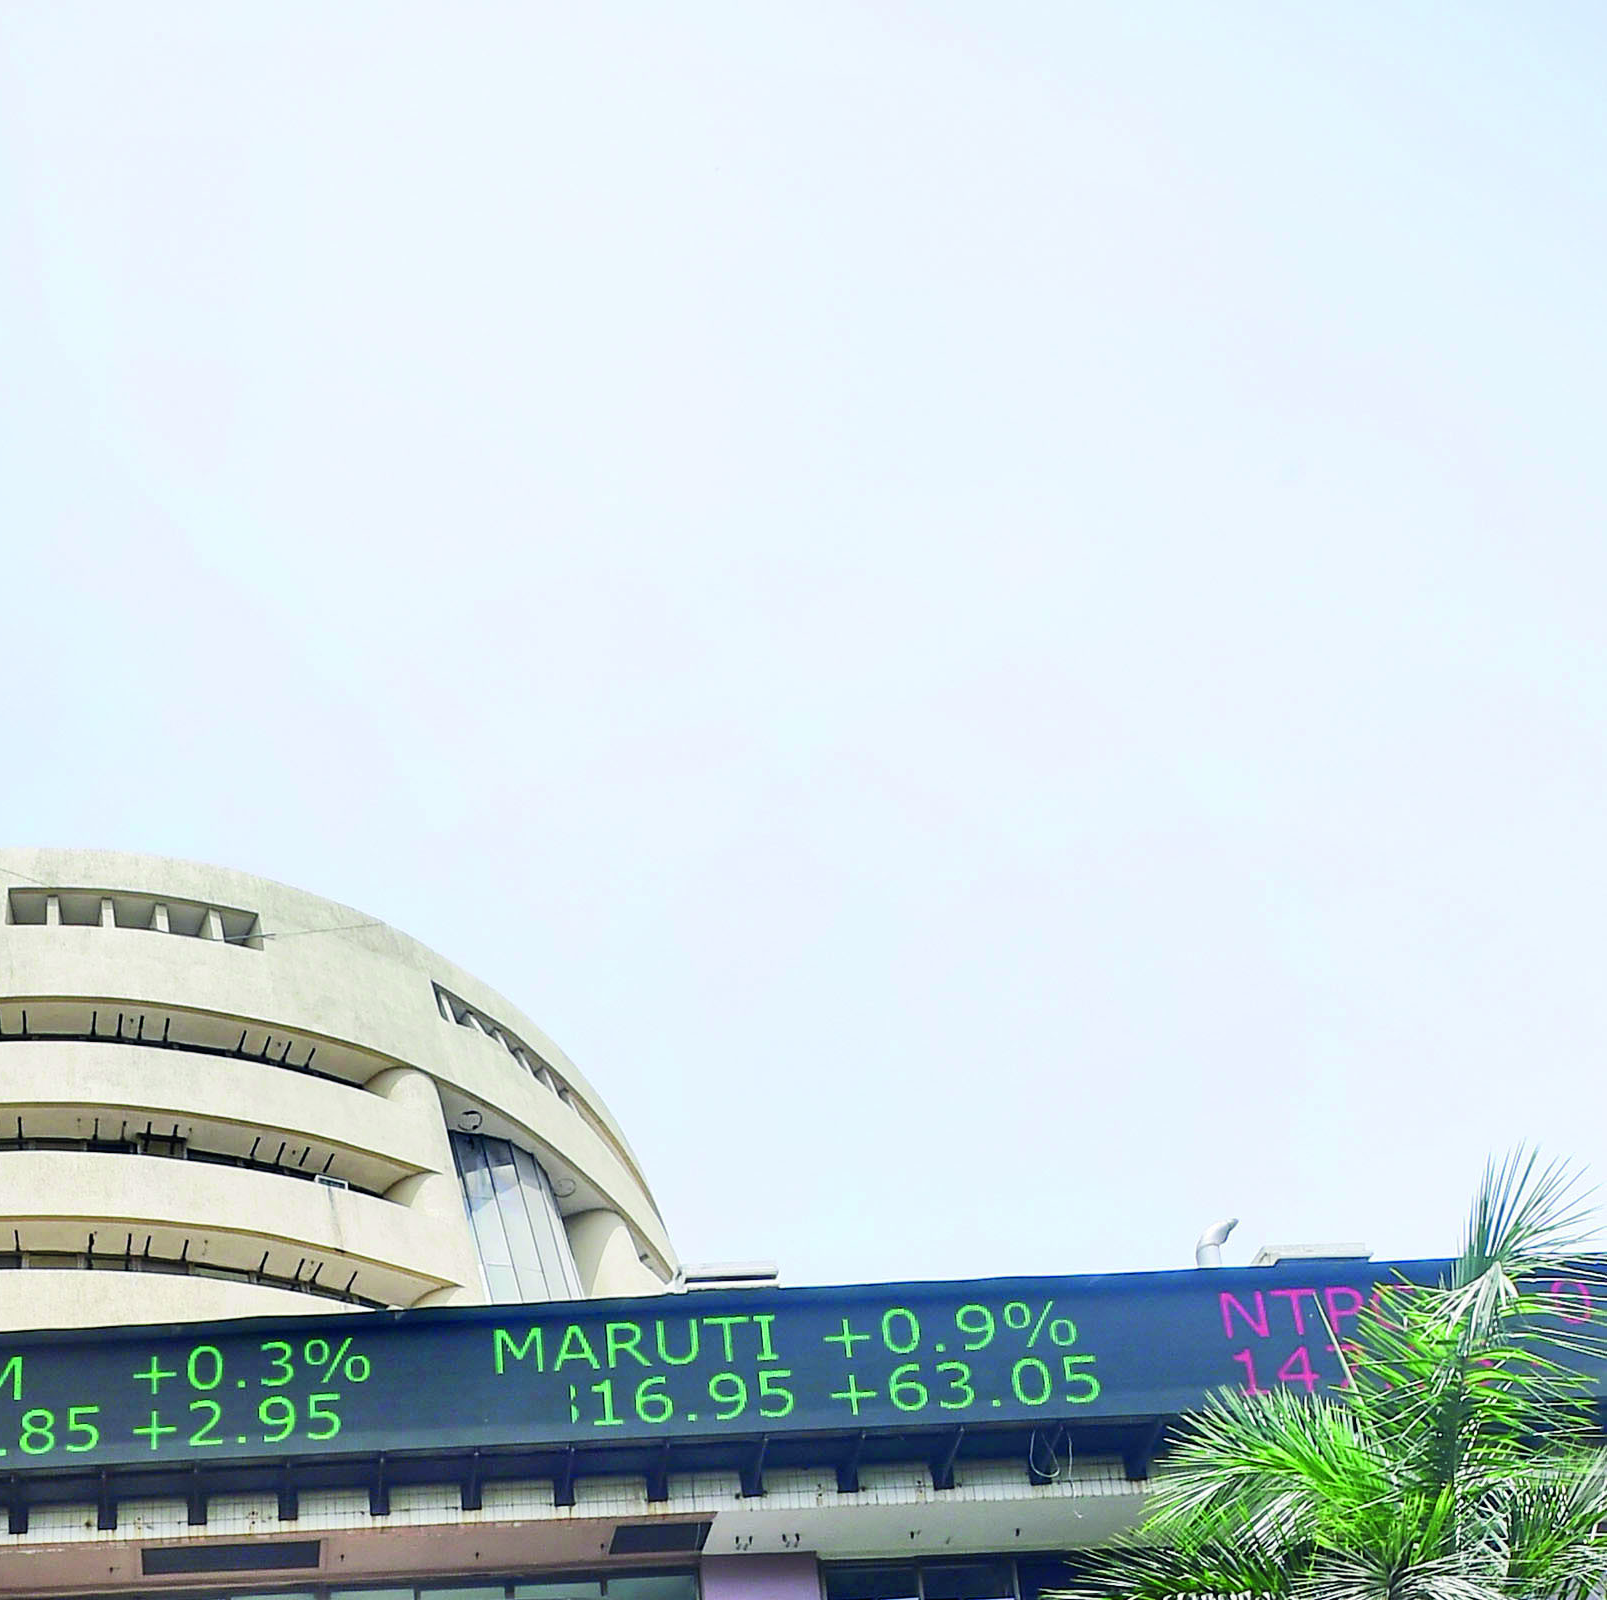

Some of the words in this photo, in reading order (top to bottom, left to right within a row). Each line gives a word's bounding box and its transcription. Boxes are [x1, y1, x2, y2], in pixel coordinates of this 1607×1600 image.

[131, 1337, 372, 1395] +0.3%
[492, 1313, 780, 1375] MARUTI
[824, 1301, 1078, 1358] +0.9%
[830, 1353, 1102, 1414] +63.05
[131, 1391, 343, 1450] +2.95
